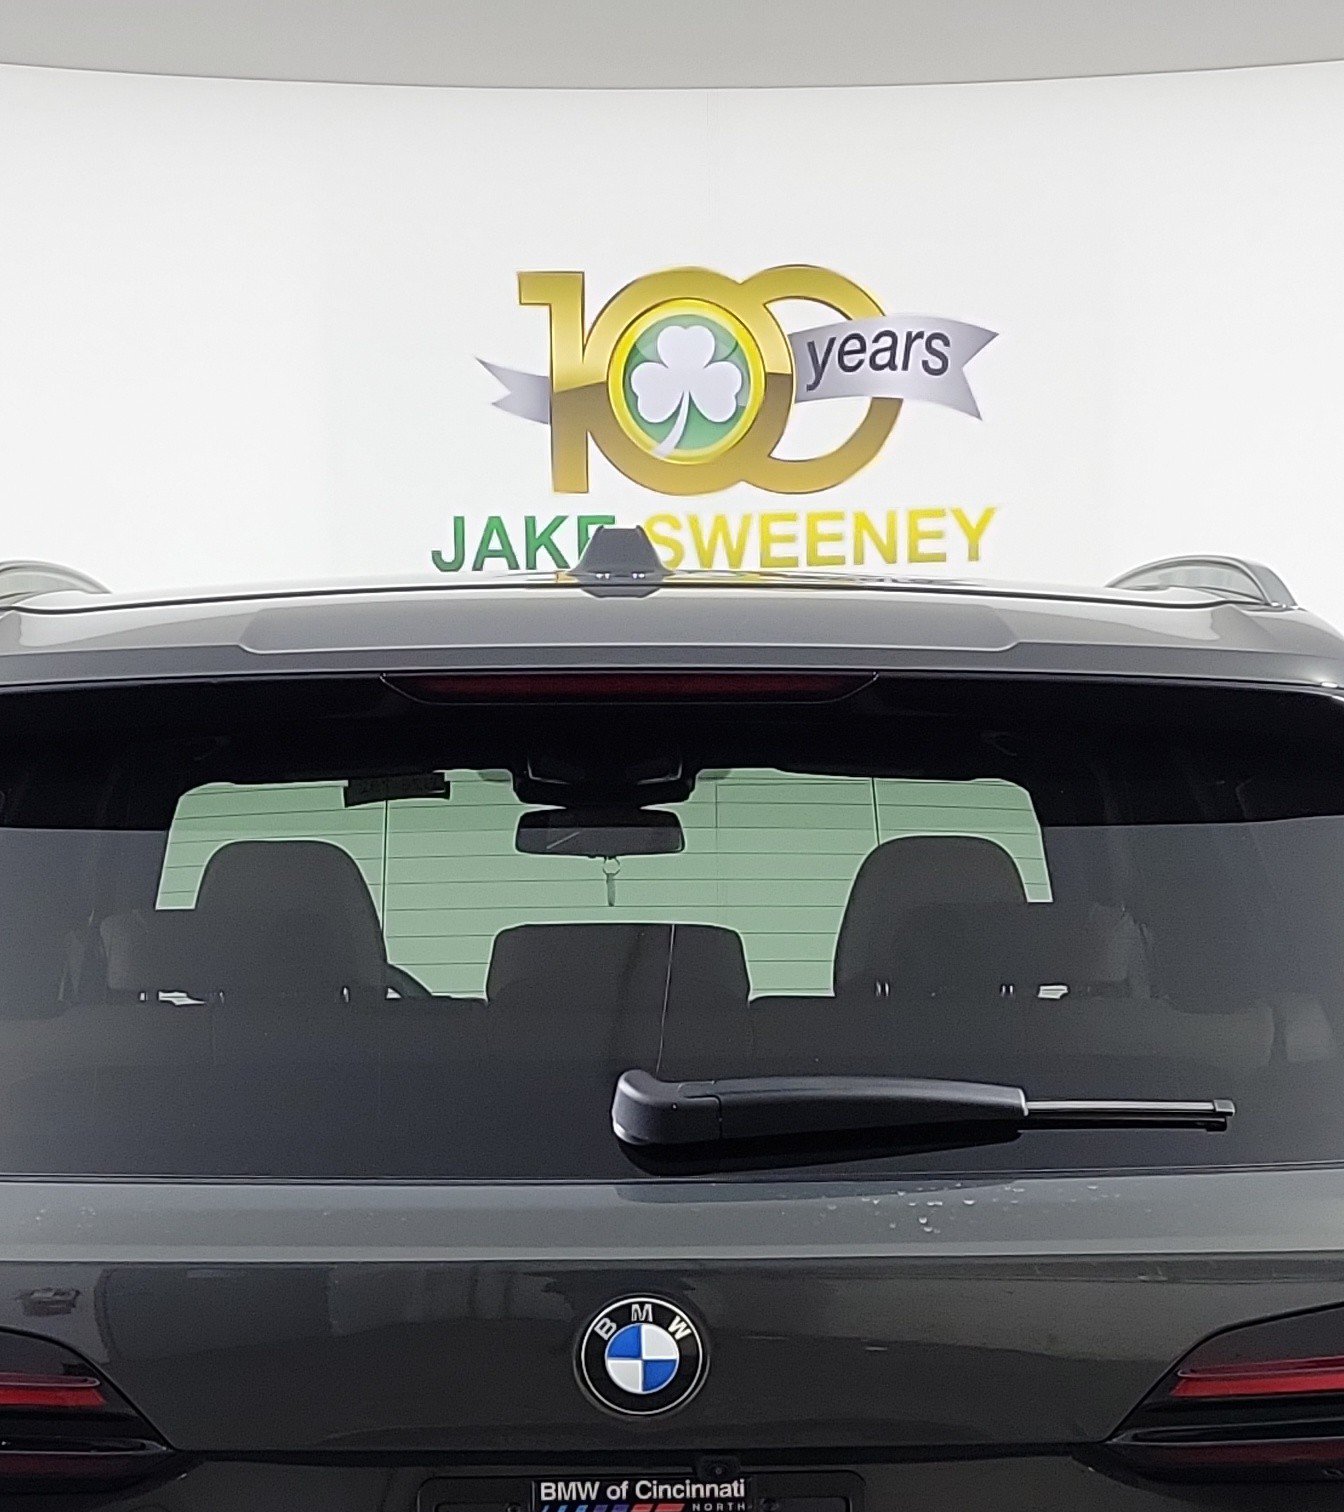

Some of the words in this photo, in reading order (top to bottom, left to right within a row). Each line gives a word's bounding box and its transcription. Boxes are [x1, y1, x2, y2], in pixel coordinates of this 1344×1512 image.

[517, 264, 904, 494] 100
[806, 327, 952, 392] years
[645, 507, 998, 569] SWEENEY
[594, 1303, 692, 1341] BMW
[540, 1482, 599, 1500] BMW
[607, 1481, 629, 1499] of
[635, 1479, 745, 1499] Cincinnati
[692, 1502, 746, 1512] NORTH
